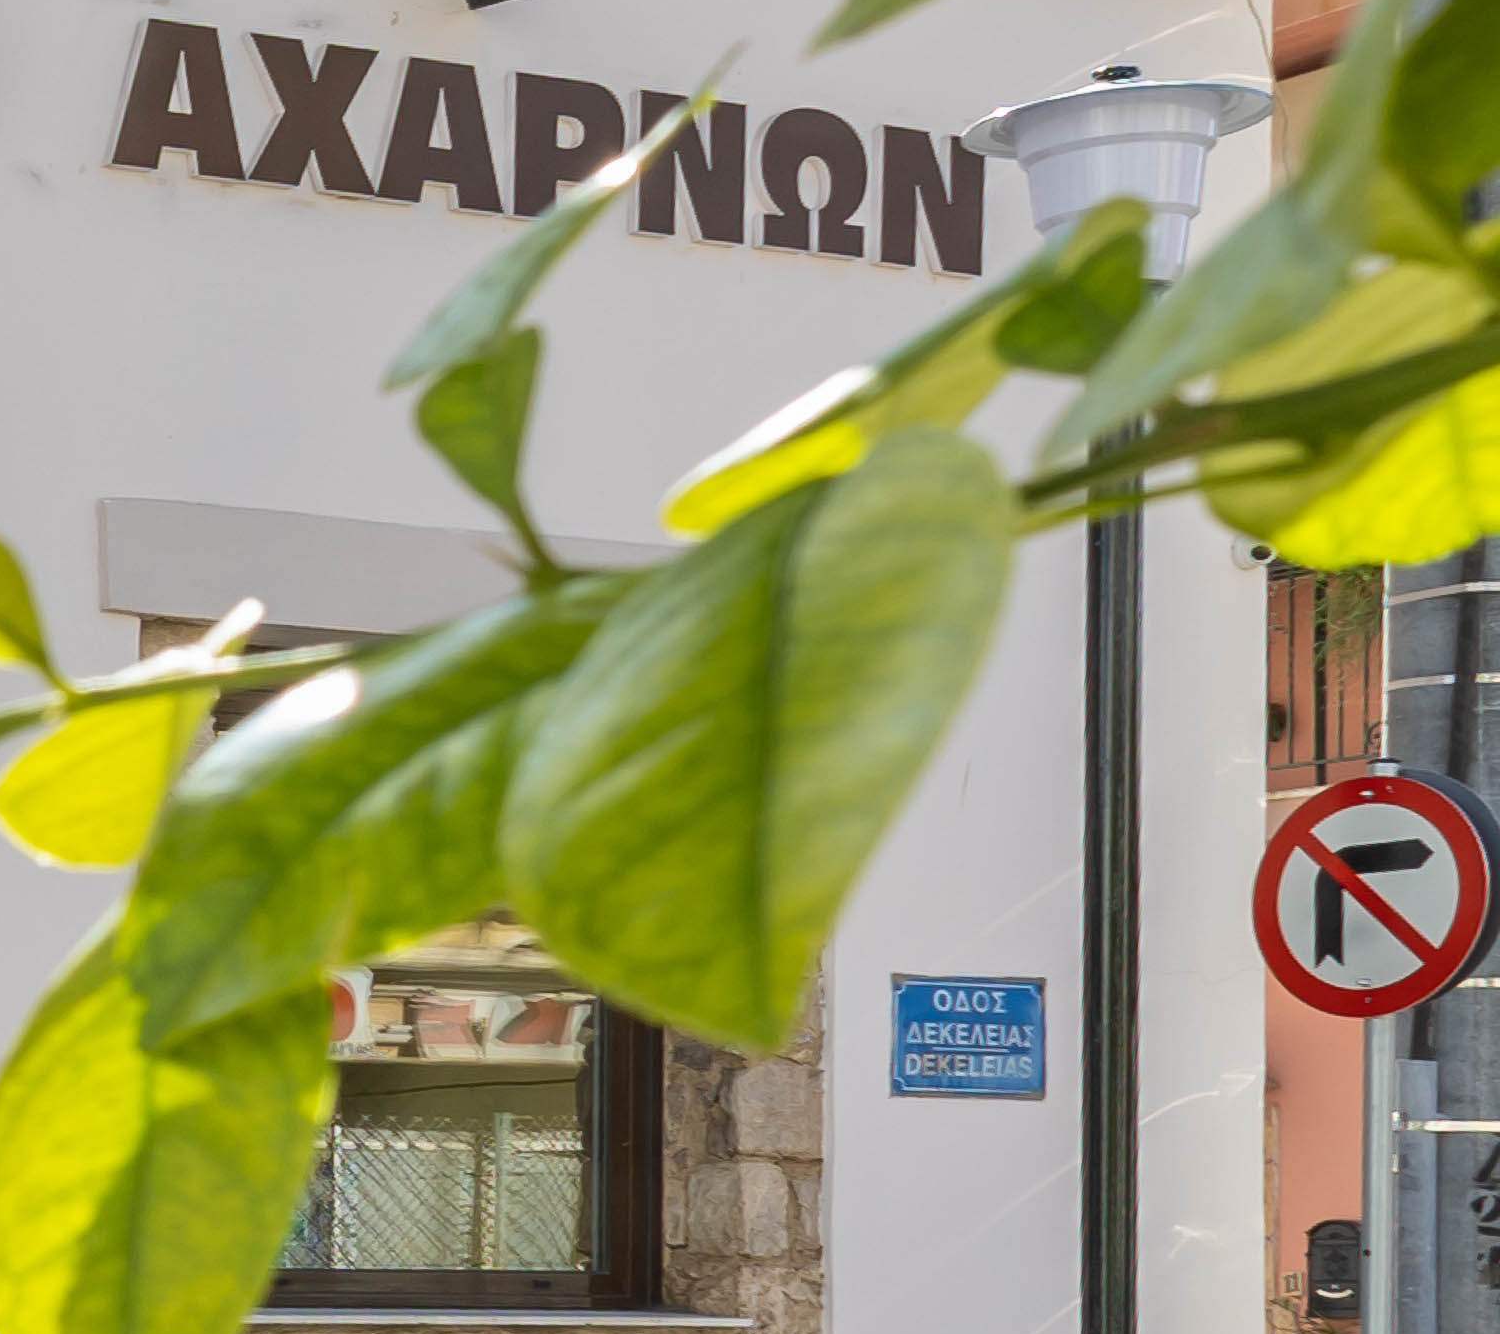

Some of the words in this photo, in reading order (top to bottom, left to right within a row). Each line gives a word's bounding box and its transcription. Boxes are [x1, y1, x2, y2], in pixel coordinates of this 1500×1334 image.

[102, 17, 986, 278] ΑΧΑΡΝΩΝ
[933, 989, 1007, 1014] ΟΔΟΣ
[906, 1021, 1035, 1047] ΔΕΚΕΛΕΙΑΣ
[905, 1053, 1033, 1079] DEKELEIAS
